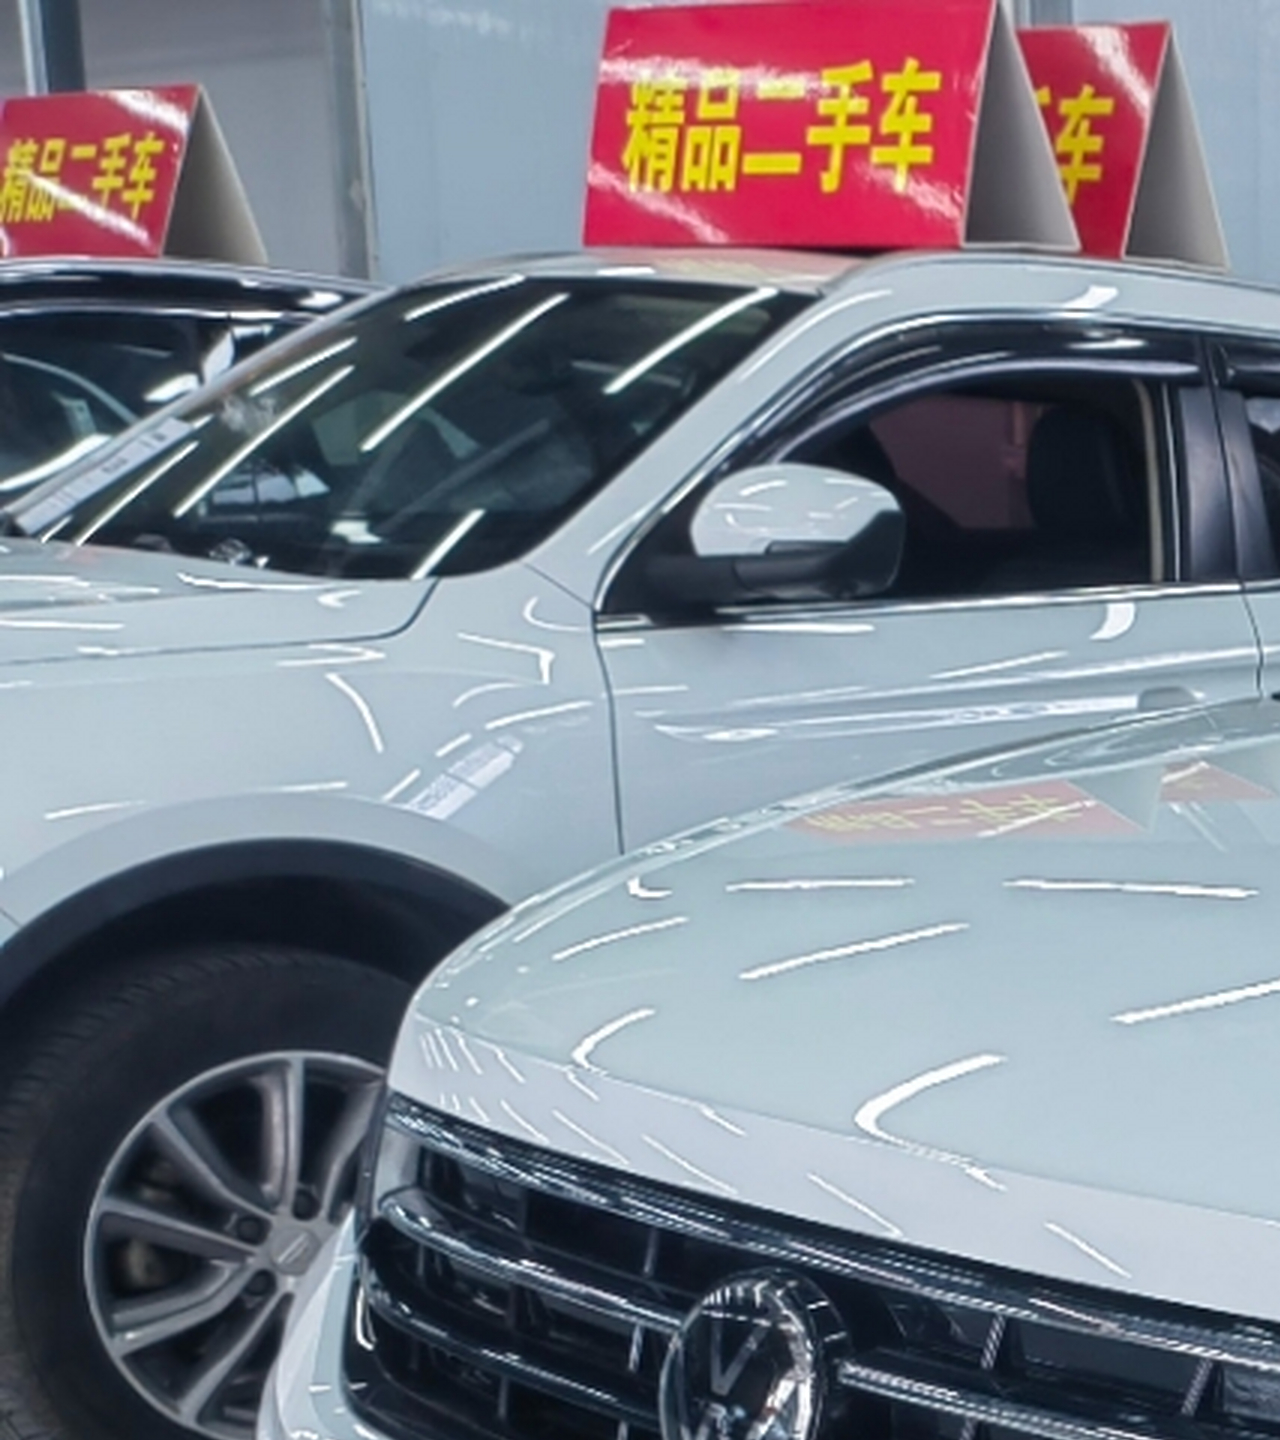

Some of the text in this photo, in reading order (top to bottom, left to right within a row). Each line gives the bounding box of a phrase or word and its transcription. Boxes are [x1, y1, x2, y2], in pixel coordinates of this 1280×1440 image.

[0, 131, 165, 222] 精品二手车
[620, 57, 942, 193] 精品二手车
[1034, 83, 1115, 207] 车
